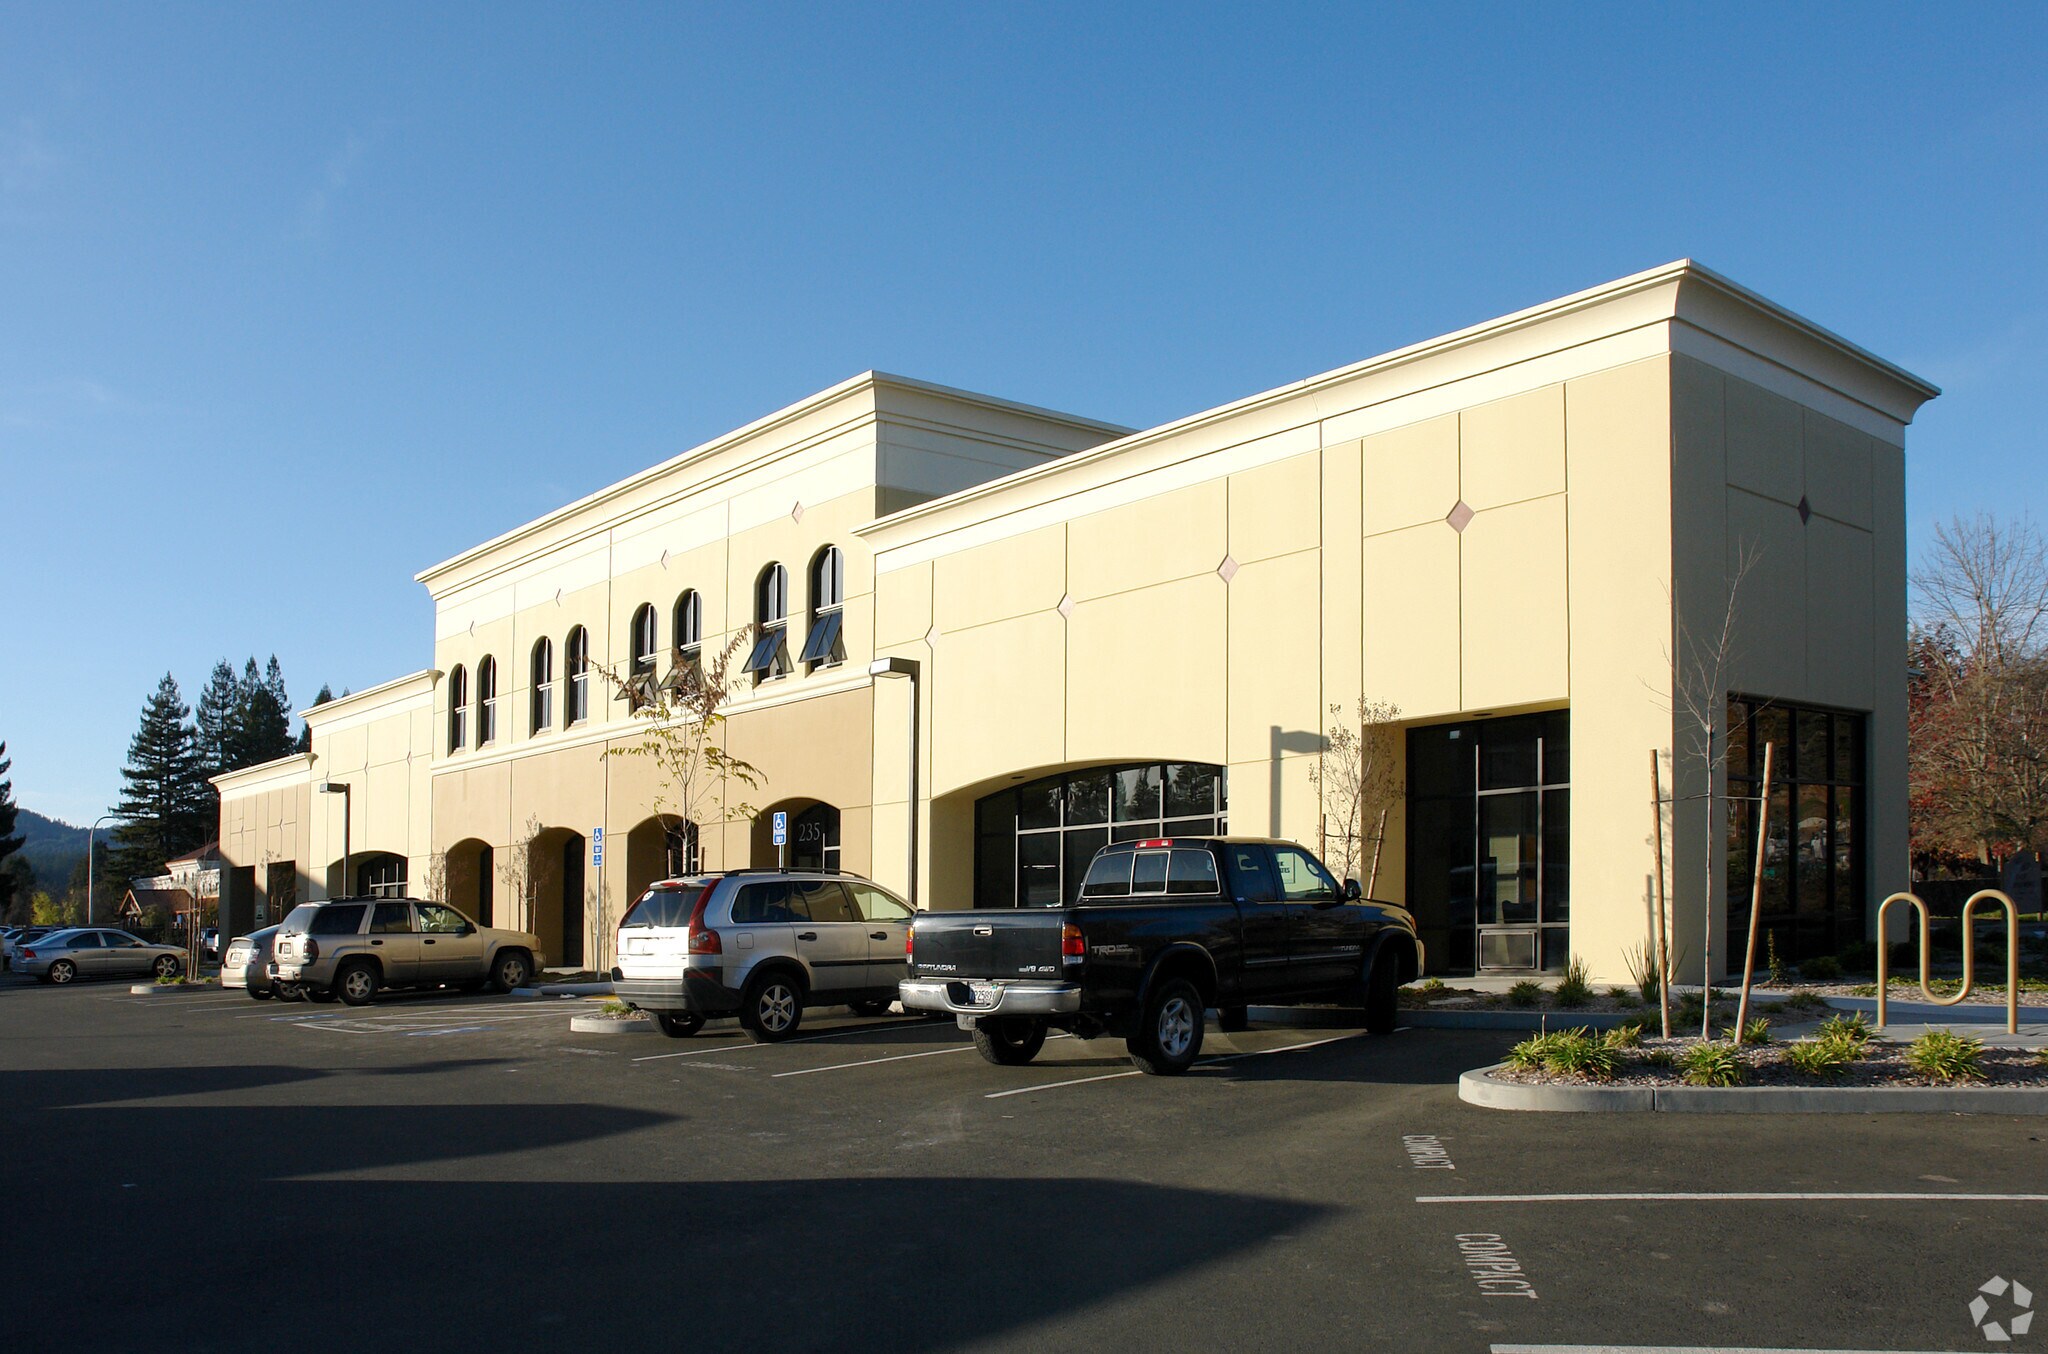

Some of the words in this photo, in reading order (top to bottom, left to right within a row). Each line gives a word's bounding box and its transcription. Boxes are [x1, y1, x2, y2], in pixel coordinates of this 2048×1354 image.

[799, 822, 821, 842] 235
[1090, 944, 1116, 956] TRD
[1402, 1134, 1456, 1170] COMPACT
[1455, 1233, 1540, 1299] COMPACT
